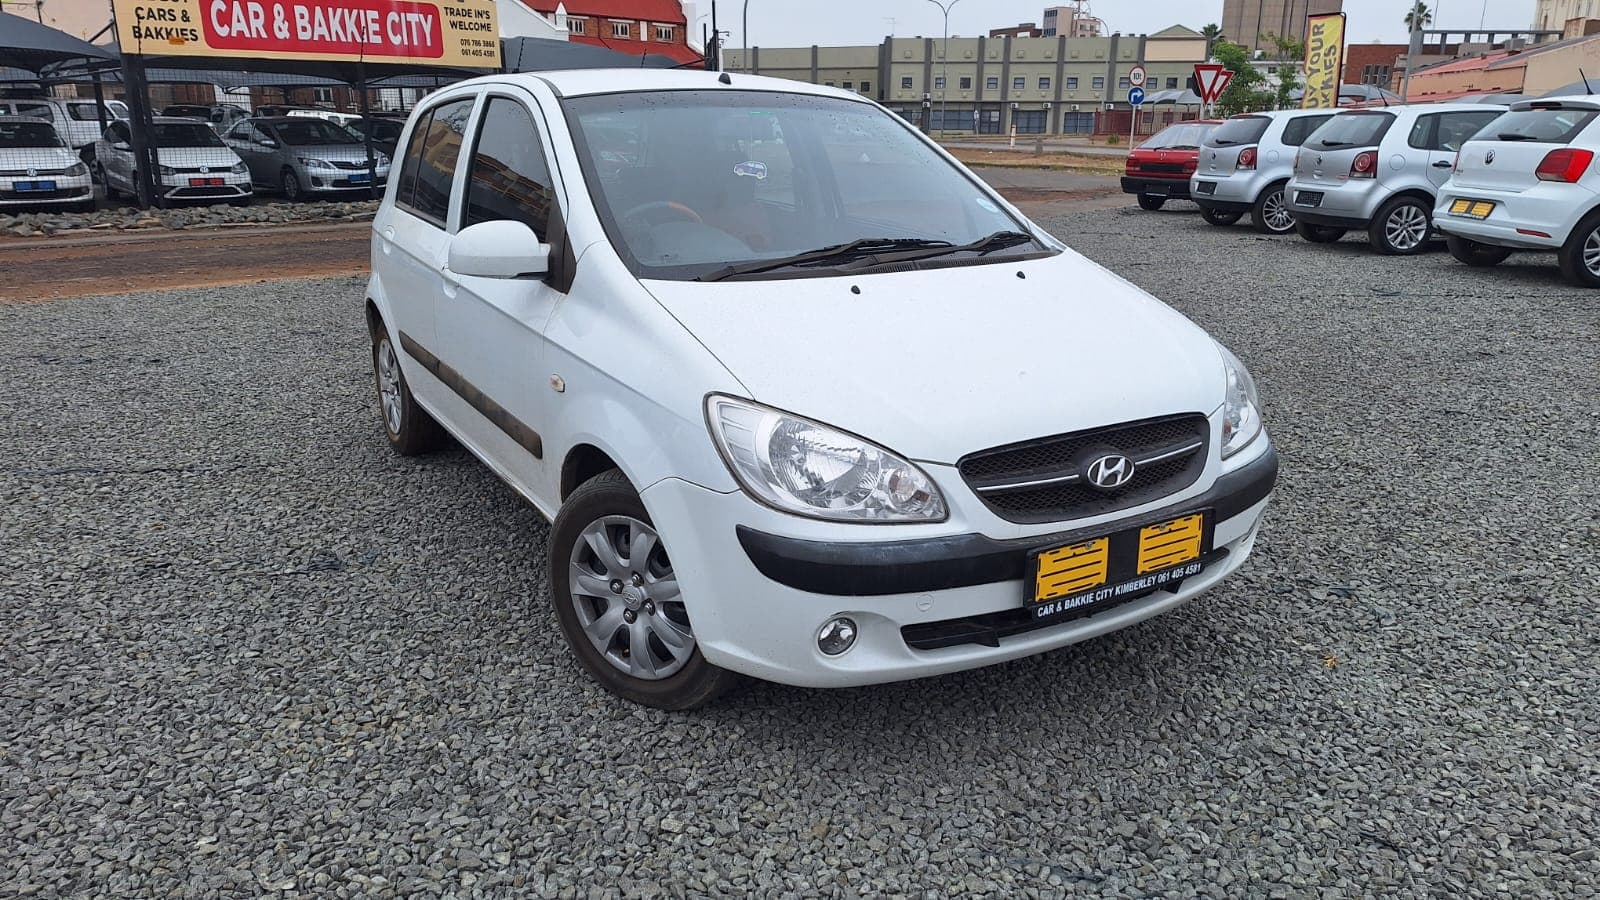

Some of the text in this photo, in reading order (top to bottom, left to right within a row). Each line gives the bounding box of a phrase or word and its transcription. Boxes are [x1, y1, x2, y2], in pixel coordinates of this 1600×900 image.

[134, 6, 191, 22] CARS &
[210, 0, 433, 47] CAR & BAKKIE CITY
[443, 6, 491, 20] TRADE IN'S
[448, 20, 492, 32] WELCOME
[132, 25, 199, 42] BAKKIES
[1306, 23, 1325, 108] UY YOUR
[1320, 44, 1337, 108] KKIES
[1037, 562, 1201, 617] CAR & BAKKIE CITY KIMBERLEY 061 405 4581
